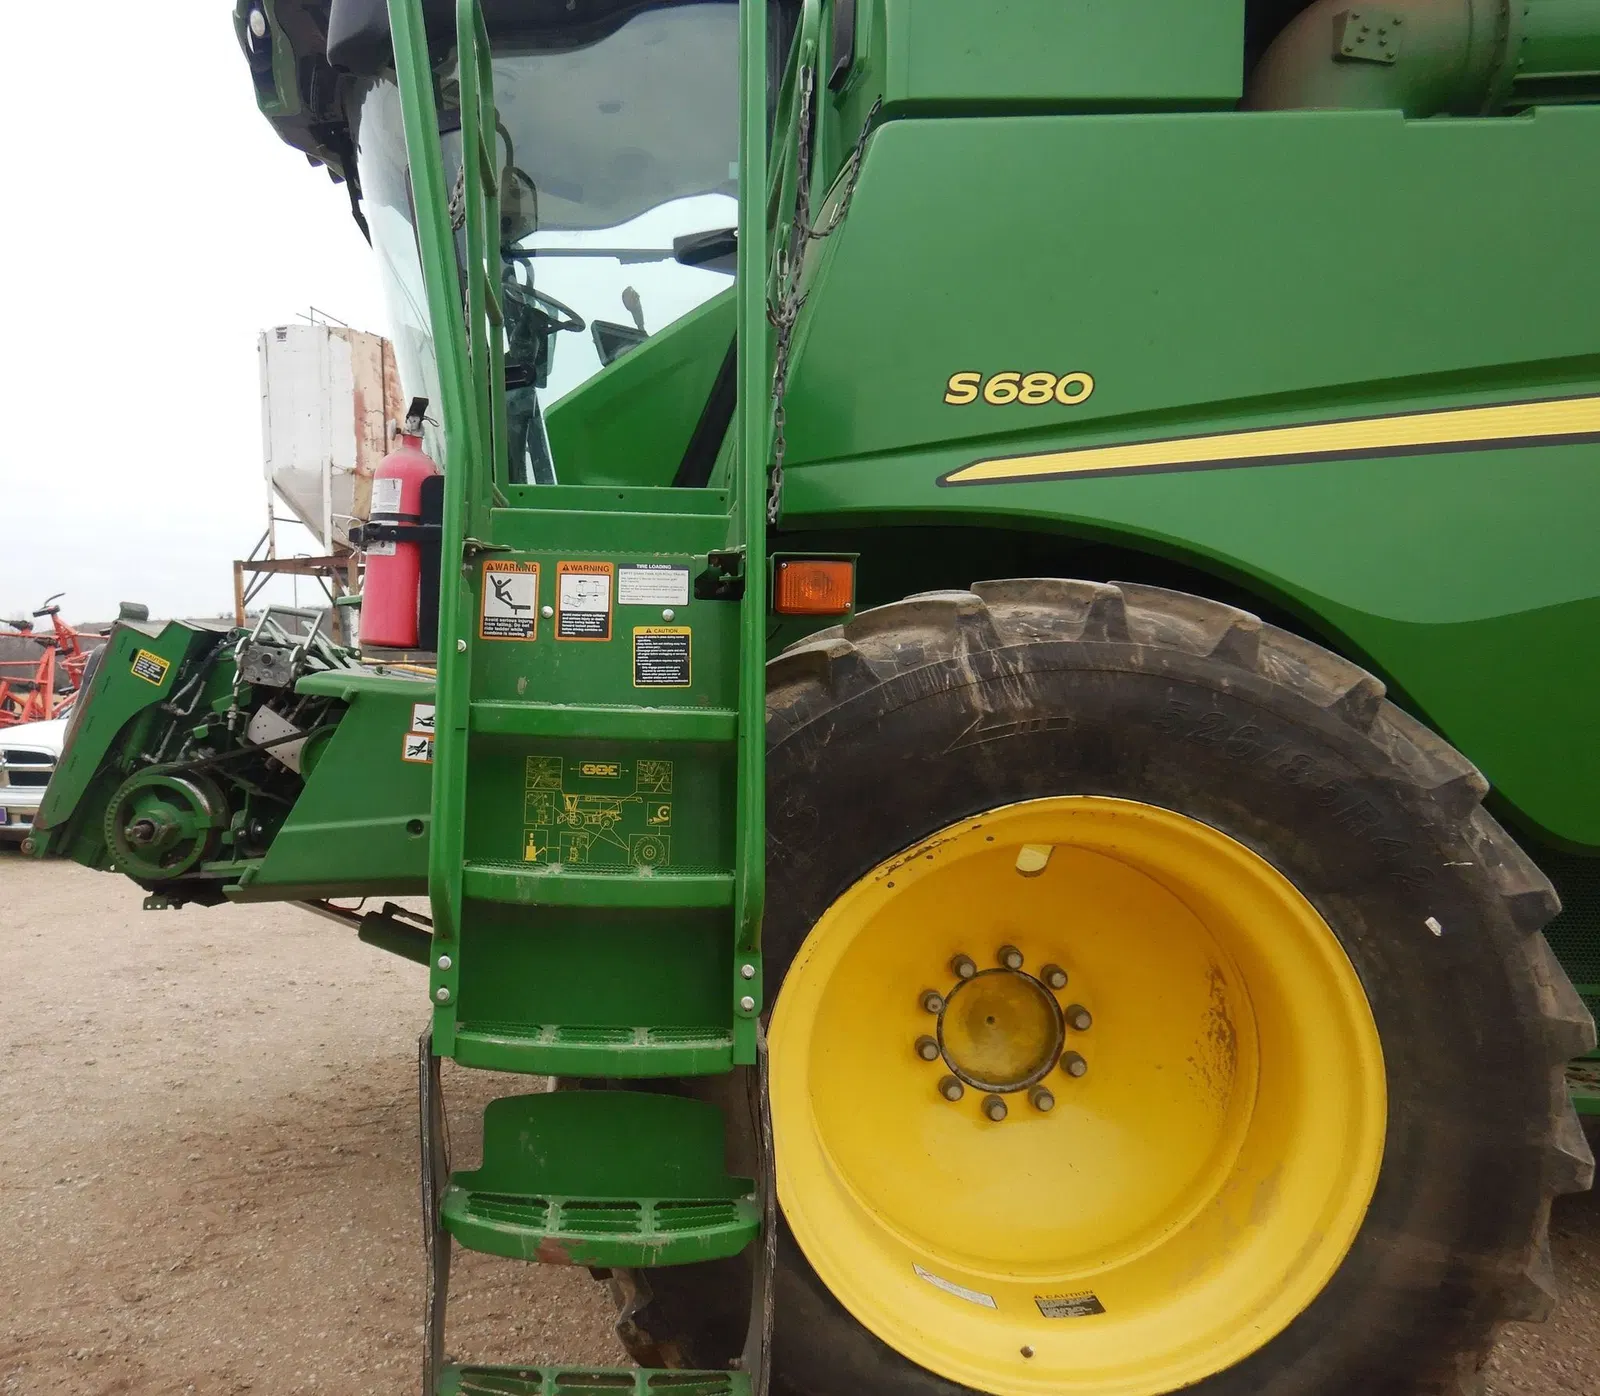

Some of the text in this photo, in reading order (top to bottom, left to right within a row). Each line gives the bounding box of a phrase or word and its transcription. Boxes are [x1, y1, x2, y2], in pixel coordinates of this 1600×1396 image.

[943, 371, 1095, 405] S680
[571, 564, 609, 572] WARNING
[1046, 1290, 1094, 1299] CAUTION
